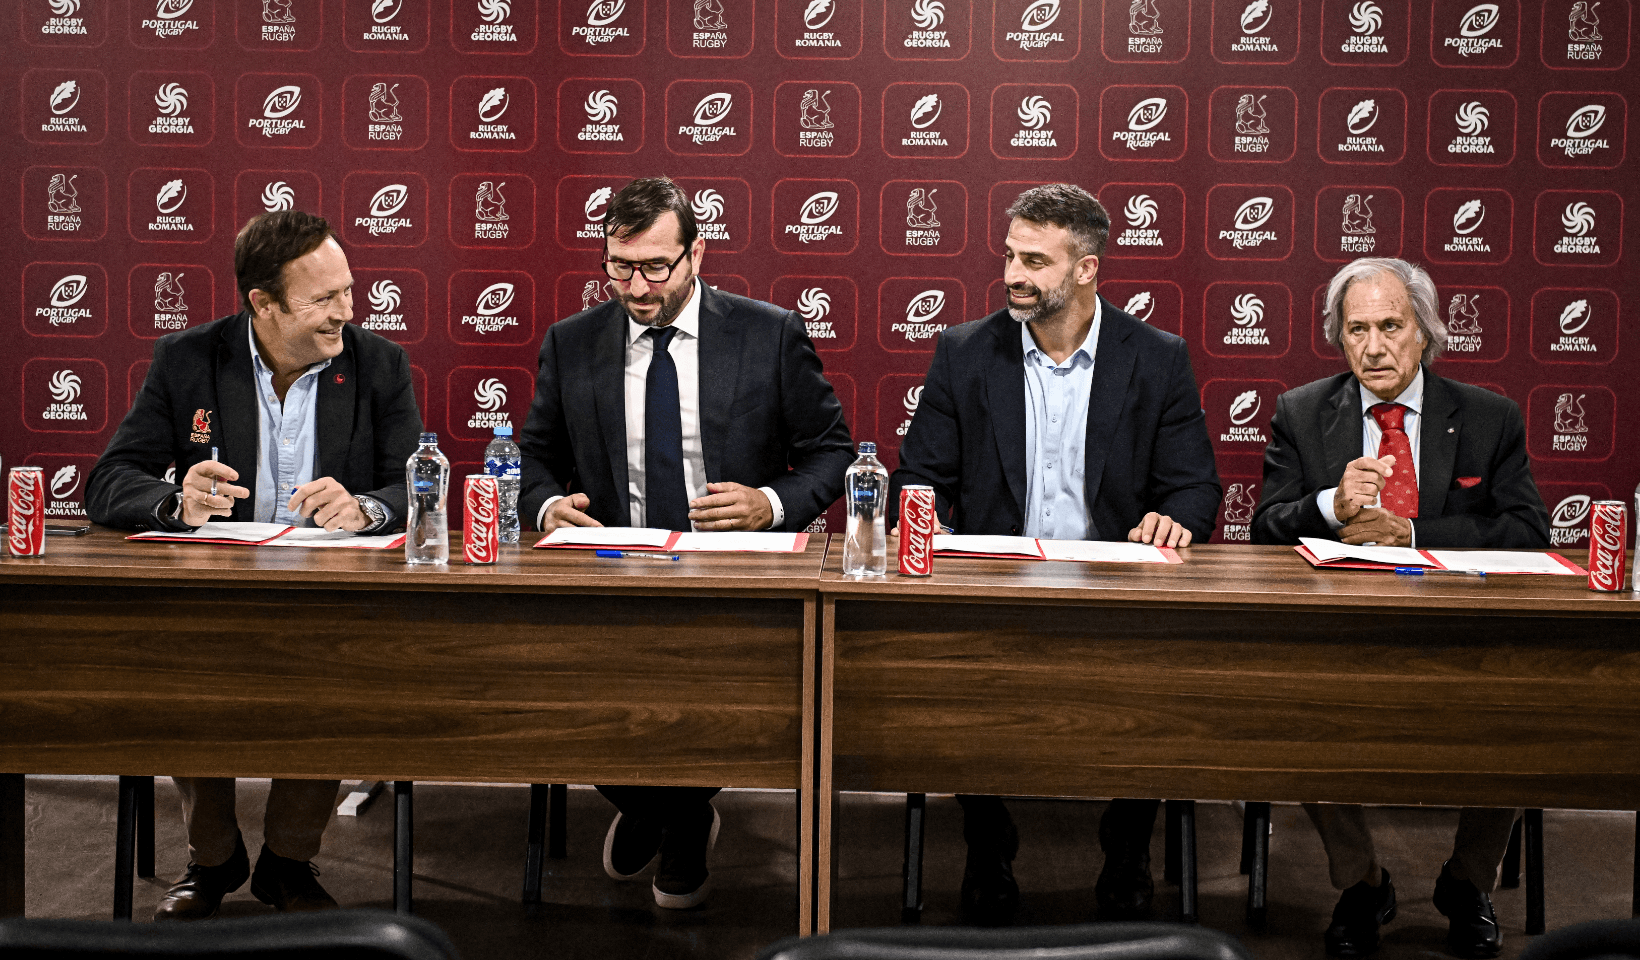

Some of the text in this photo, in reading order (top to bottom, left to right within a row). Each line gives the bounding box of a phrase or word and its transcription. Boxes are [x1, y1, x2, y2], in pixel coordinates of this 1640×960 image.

[49, 18, 84, 26] RUGBY
[142, 20, 199, 29] PORTUGAL
[41, 26, 87, 35] GEORGIA
[478, 25, 514, 33] RUGBY
[571, 27, 630, 36] PORTUGAL
[261, 33, 296, 41] RUGBY
[363, 33, 410, 41] ROMANIA
[470, 33, 517, 42] GEORGIA
[692, 32, 727, 40] ESPAÑA
[912, 31, 947, 39] RUGBY
[1006, 33, 1064, 42] PORTUGAL
[692, 40, 727, 48] RUGBY
[904, 39, 950, 48] GEORGIA
[1128, 37, 1163, 45] ESPAÑA
[1349, 36, 1384, 44] RUGBY
[1444, 38, 1503, 47] PORTUGAL
[1128, 45, 1163, 53] RUGBY
[1231, 44, 1279, 52] ROMANIA
[1341, 44, 1388, 53] GEORGIA
[1567, 43, 1602, 51] ESPAÑA
[1567, 51, 1602, 60] RUGBY
[50, 117, 80, 125] RUGBY
[156, 117, 191, 125] RUGBY
[248, 118, 306, 128] PORTUGAL
[148, 125, 194, 134] GEORGIA
[368, 124, 403, 132] ESPAÑA
[585, 124, 620, 133] RUGBY
[678, 126, 736, 135] PORTUGAL
[368, 132, 403, 140] RUGBY
[470, 132, 516, 140] ROMANIA
[577, 132, 624, 141] GEORGIA
[799, 131, 834, 139] ESPAÑA
[1018, 130, 1053, 138] RUGBY
[1112, 132, 1171, 141] PORTUGAL
[799, 139, 834, 147] RUGBY
[1010, 138, 1057, 147] GEORGIA
[1234, 136, 1270, 144] ESPAÑA
[1346, 137, 1377, 145] RUGBY
[1456, 137, 1491, 145] RUGBY
[1550, 138, 1610, 148] PORTUGAL
[1234, 144, 1270, 153] RUGBY
[1338, 144, 1385, 152] ROMANIA
[1447, 145, 1495, 154] GEORGIA
[47, 215, 82, 223] ESPAÑA
[355, 217, 412, 227] PORTUGAL
[47, 223, 82, 231] RUGBY
[148, 223, 194, 231] ROMANIA
[475, 223, 509, 231] ESPAÑA
[585, 223, 604, 231] RUG
[785, 225, 843, 234] PORTUGAL
[475, 231, 509, 239] RUGBY
[697, 231, 730, 240] ORGIA
[905, 230, 940, 238] ESPAÑA
[1125, 229, 1160, 237] RUGBY
[1219, 230, 1278, 240] PORTUGAL
[905, 238, 940, 246] RUGBY
[1117, 237, 1164, 246] GEORGIA
[1340, 236, 1376, 244] ESPAÑA
[1453, 237, 1484, 245] RUGBY
[1561, 236, 1597, 245] RUGBY
[1340, 244, 1376, 252] RUGBY
[1444, 244, 1491, 252] ROMANIA
[1553, 244, 1601, 254] GEORGIA
[35, 308, 93, 317] PORTUGAL
[154, 313, 188, 321] ESPAÑA
[369, 314, 404, 322] RUGBY
[461, 316, 519, 325] PORTUGAL
[154, 321, 188, 330] RUGBY
[362, 322, 407, 331] GEORGIA
[805, 322, 833, 330] UGBY
[1231, 328, 1266, 336] RUGBY
[1223, 336, 1270, 345] GEORGIA
[1447, 335, 1482, 343] ESPAÑA
[1559, 336, 1590, 344] RUGBY
[1447, 343, 1482, 352] RUGBY
[1550, 344, 1597, 352] ROMANIA
[50, 404, 84, 412] RUGBY
[42, 412, 87, 421] GEORGIA
[475, 412, 509, 420] RUGBY
[467, 420, 513, 428] GEORGIA
[1229, 427, 1259, 435] RUGBY
[1220, 434, 1267, 442] ROMANIA
[1552, 435, 1588, 443] ESPAÑA
[1552, 443, 1588, 452] RUGBY
[51, 501, 80, 509] RUGBY
[44, 508, 87, 516] ROMANIA
[1223, 524, 1250, 532] ESPAÑ
[1223, 532, 1250, 540] RUGB
[1550, 527, 1590, 538] RTUGA
